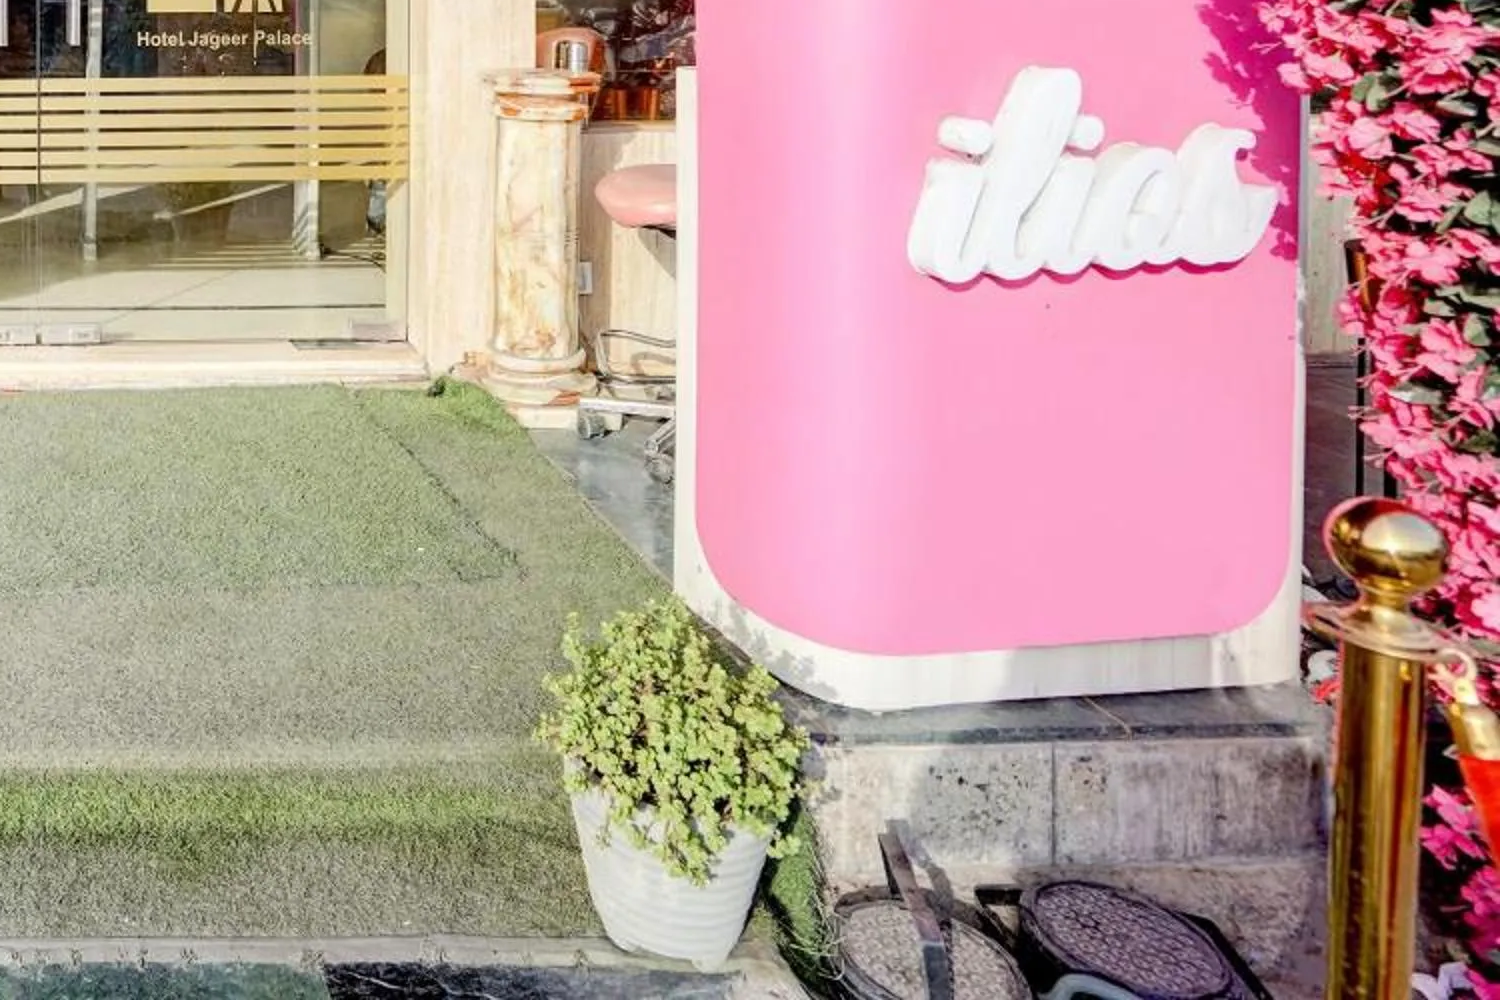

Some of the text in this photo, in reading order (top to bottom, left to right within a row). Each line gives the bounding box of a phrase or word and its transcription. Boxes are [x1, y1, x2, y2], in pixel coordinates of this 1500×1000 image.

[136, 30, 313, 50] Hotel Jageer Palace
